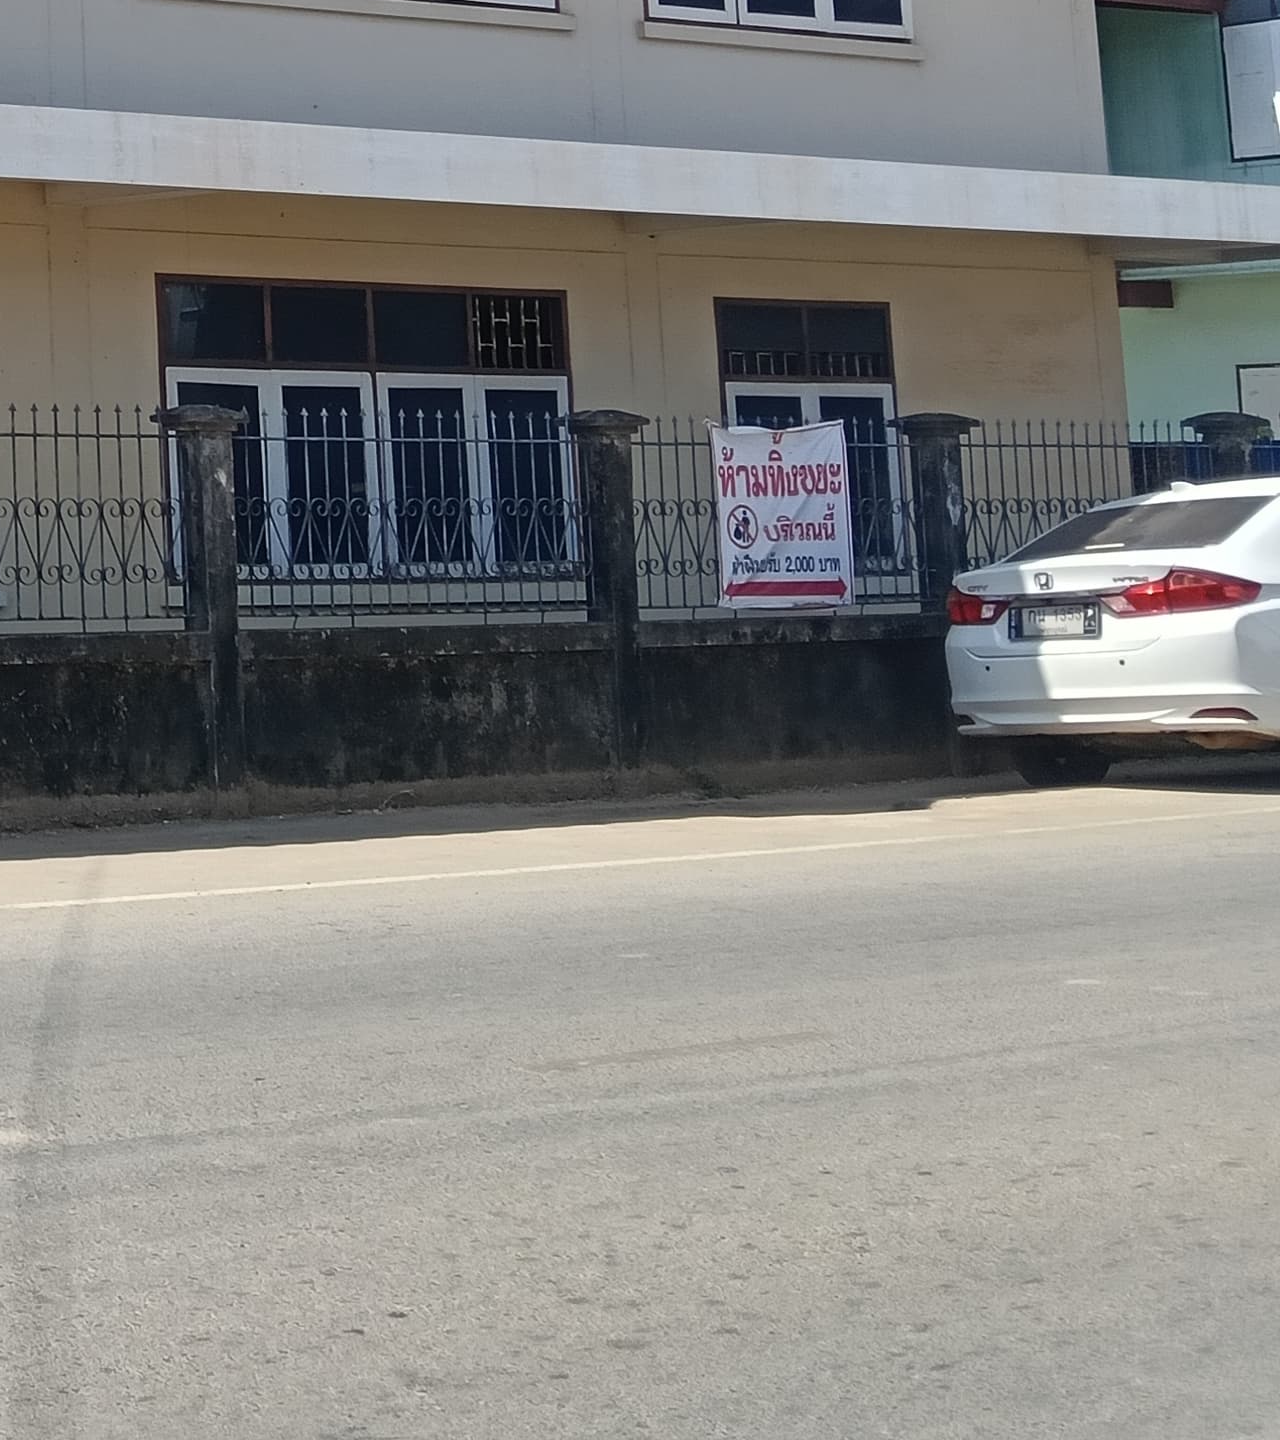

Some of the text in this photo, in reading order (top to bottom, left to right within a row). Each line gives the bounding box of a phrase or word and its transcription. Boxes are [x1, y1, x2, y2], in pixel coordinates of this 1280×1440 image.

[718, 432, 842, 497] ห้ามทิ้งขยะ
[764, 503, 836, 542] บริเวณนี้
[785, 556, 815, 574] 2,000
[819, 557, 841, 573] บาท
